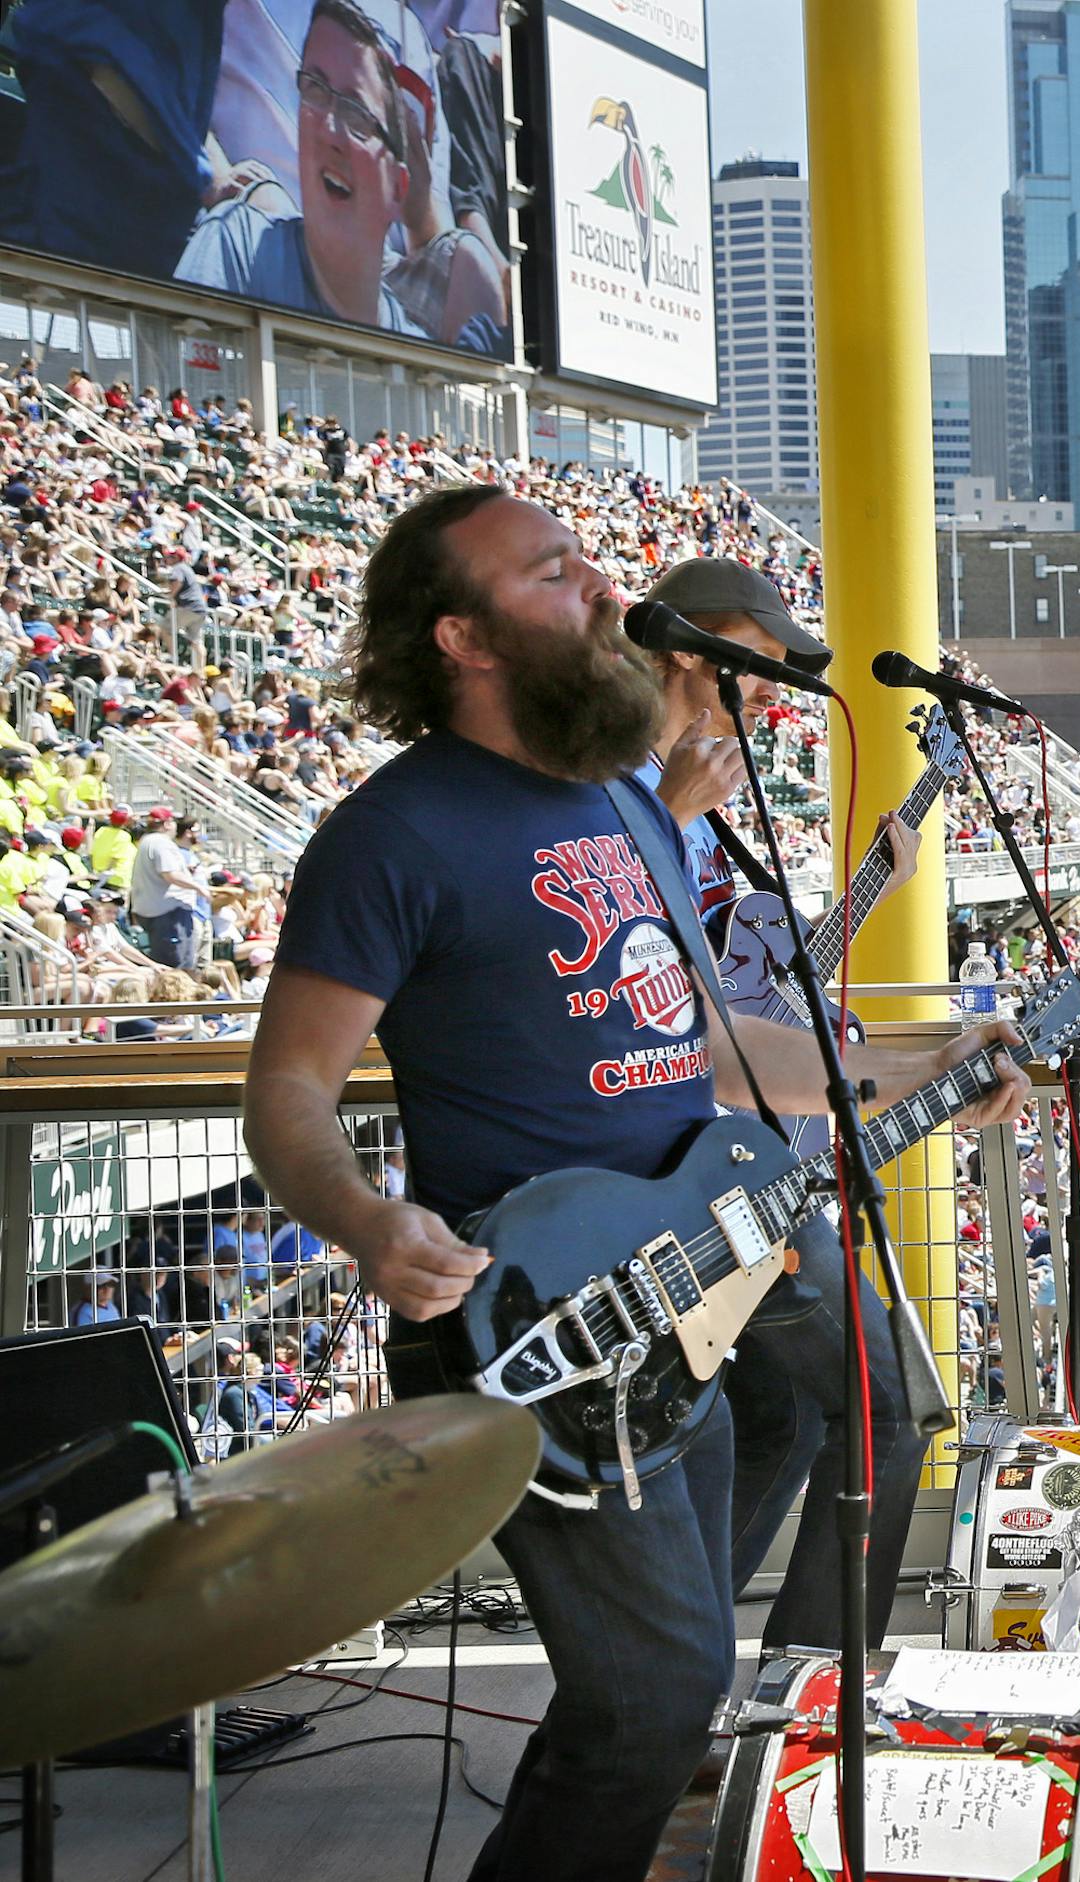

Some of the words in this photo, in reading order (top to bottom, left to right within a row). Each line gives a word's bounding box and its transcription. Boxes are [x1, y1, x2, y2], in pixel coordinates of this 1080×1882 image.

[566, 201, 636, 276] Treasure
[653, 232, 700, 295] Island
[570, 270, 626, 299] RESORT
[633, 291, 642, 304] &
[650, 296, 702, 322] CASINO
[599, 311, 620, 326] RED
[624, 1041, 690, 1065] AMERICAN
